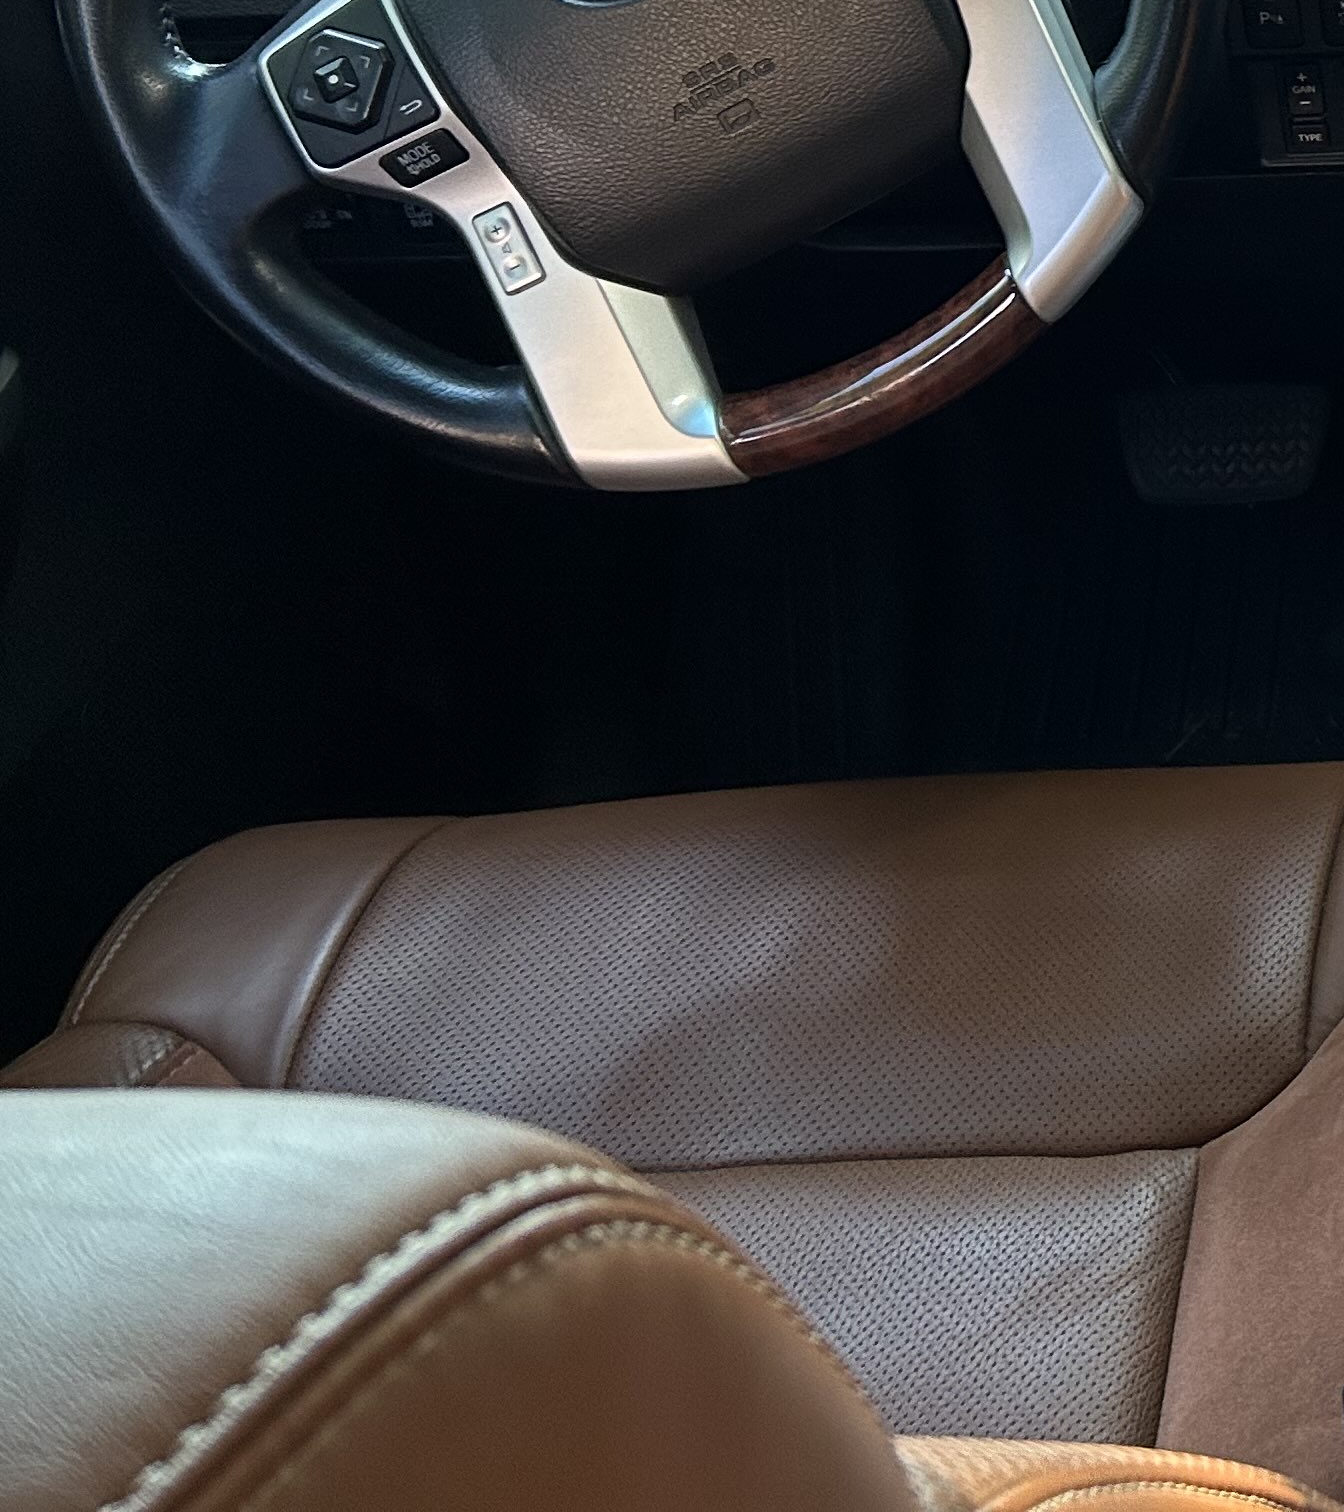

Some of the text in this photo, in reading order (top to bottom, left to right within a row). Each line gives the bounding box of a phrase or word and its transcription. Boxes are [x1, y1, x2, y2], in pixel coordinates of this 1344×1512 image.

[1291, 85, 1316, 94] GAIN
[1298, 133, 1324, 142] TYPE
[396, 141, 436, 167] MODE
